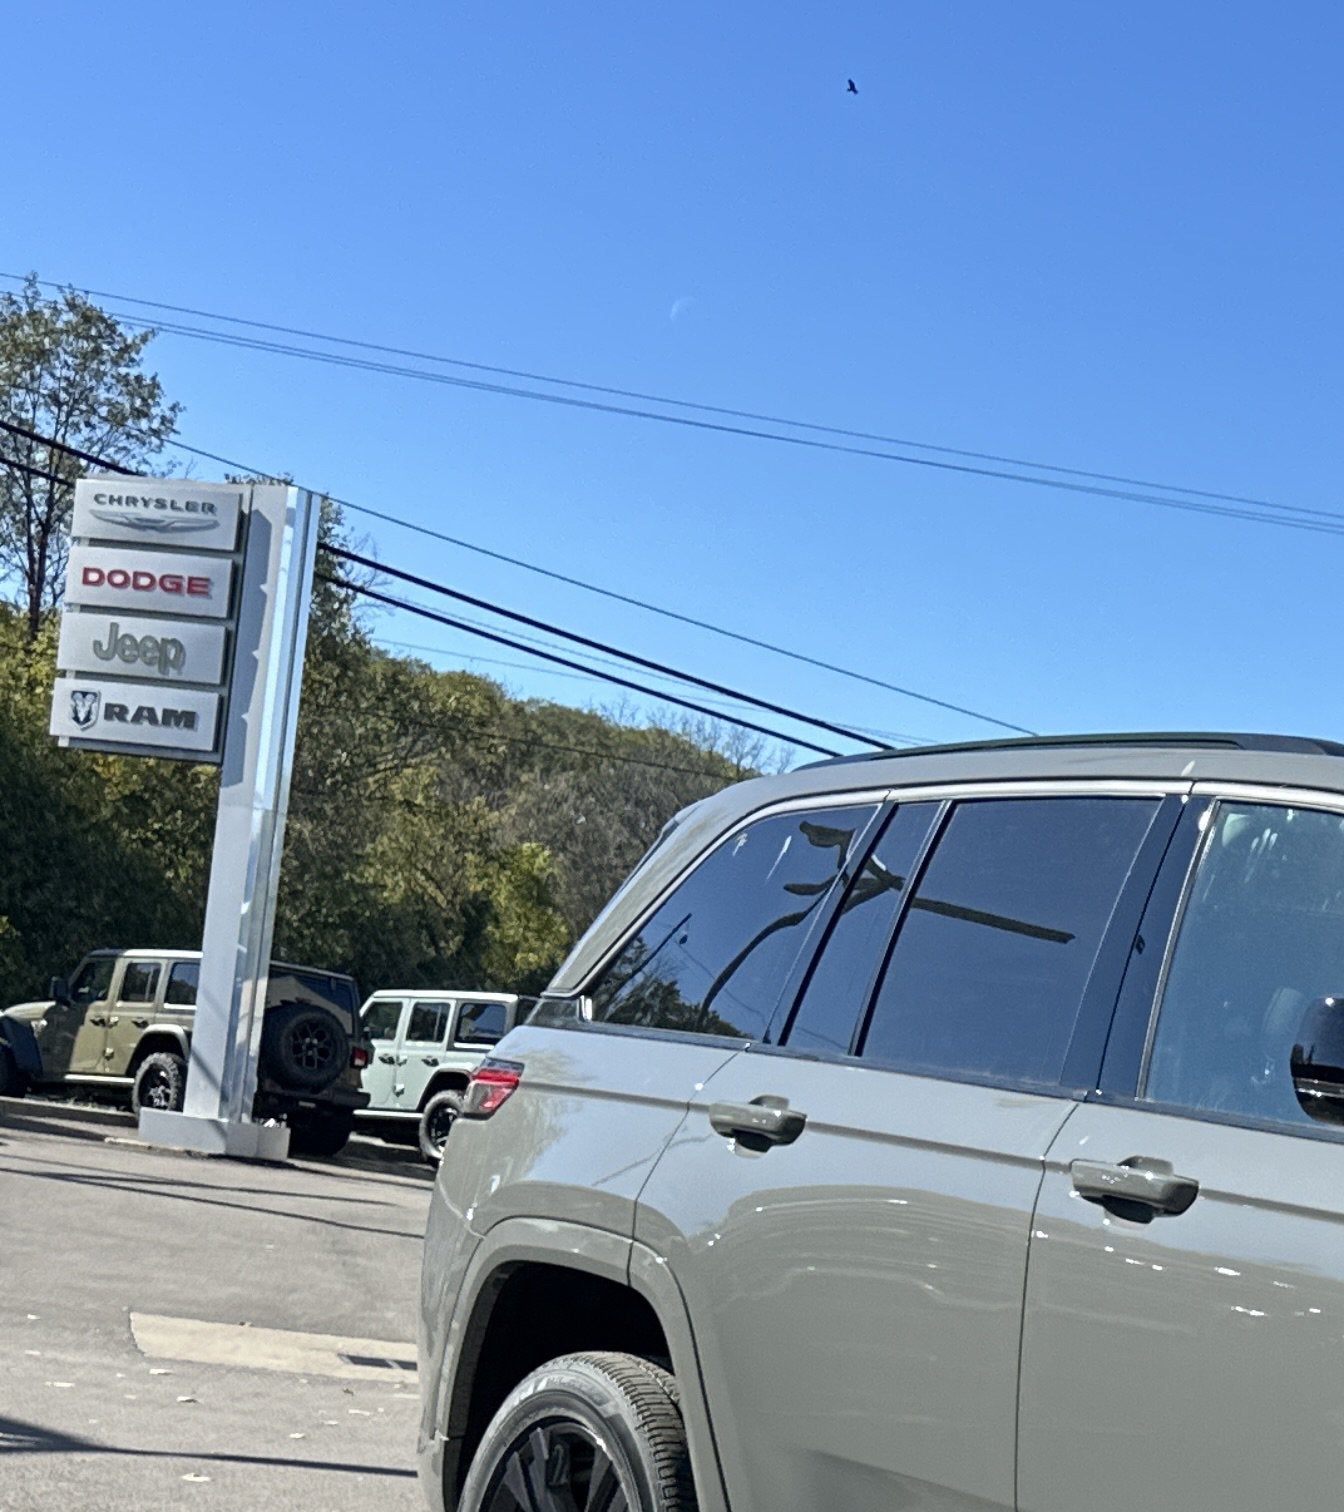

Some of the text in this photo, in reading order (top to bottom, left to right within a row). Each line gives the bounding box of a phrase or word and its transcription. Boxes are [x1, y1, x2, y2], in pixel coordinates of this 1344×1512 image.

[93, 493, 217, 515] CHRYSLER
[82, 567, 211, 596] DODGE
[94, 622, 185, 674] Jeep
[104, 702, 196, 731] RAM
